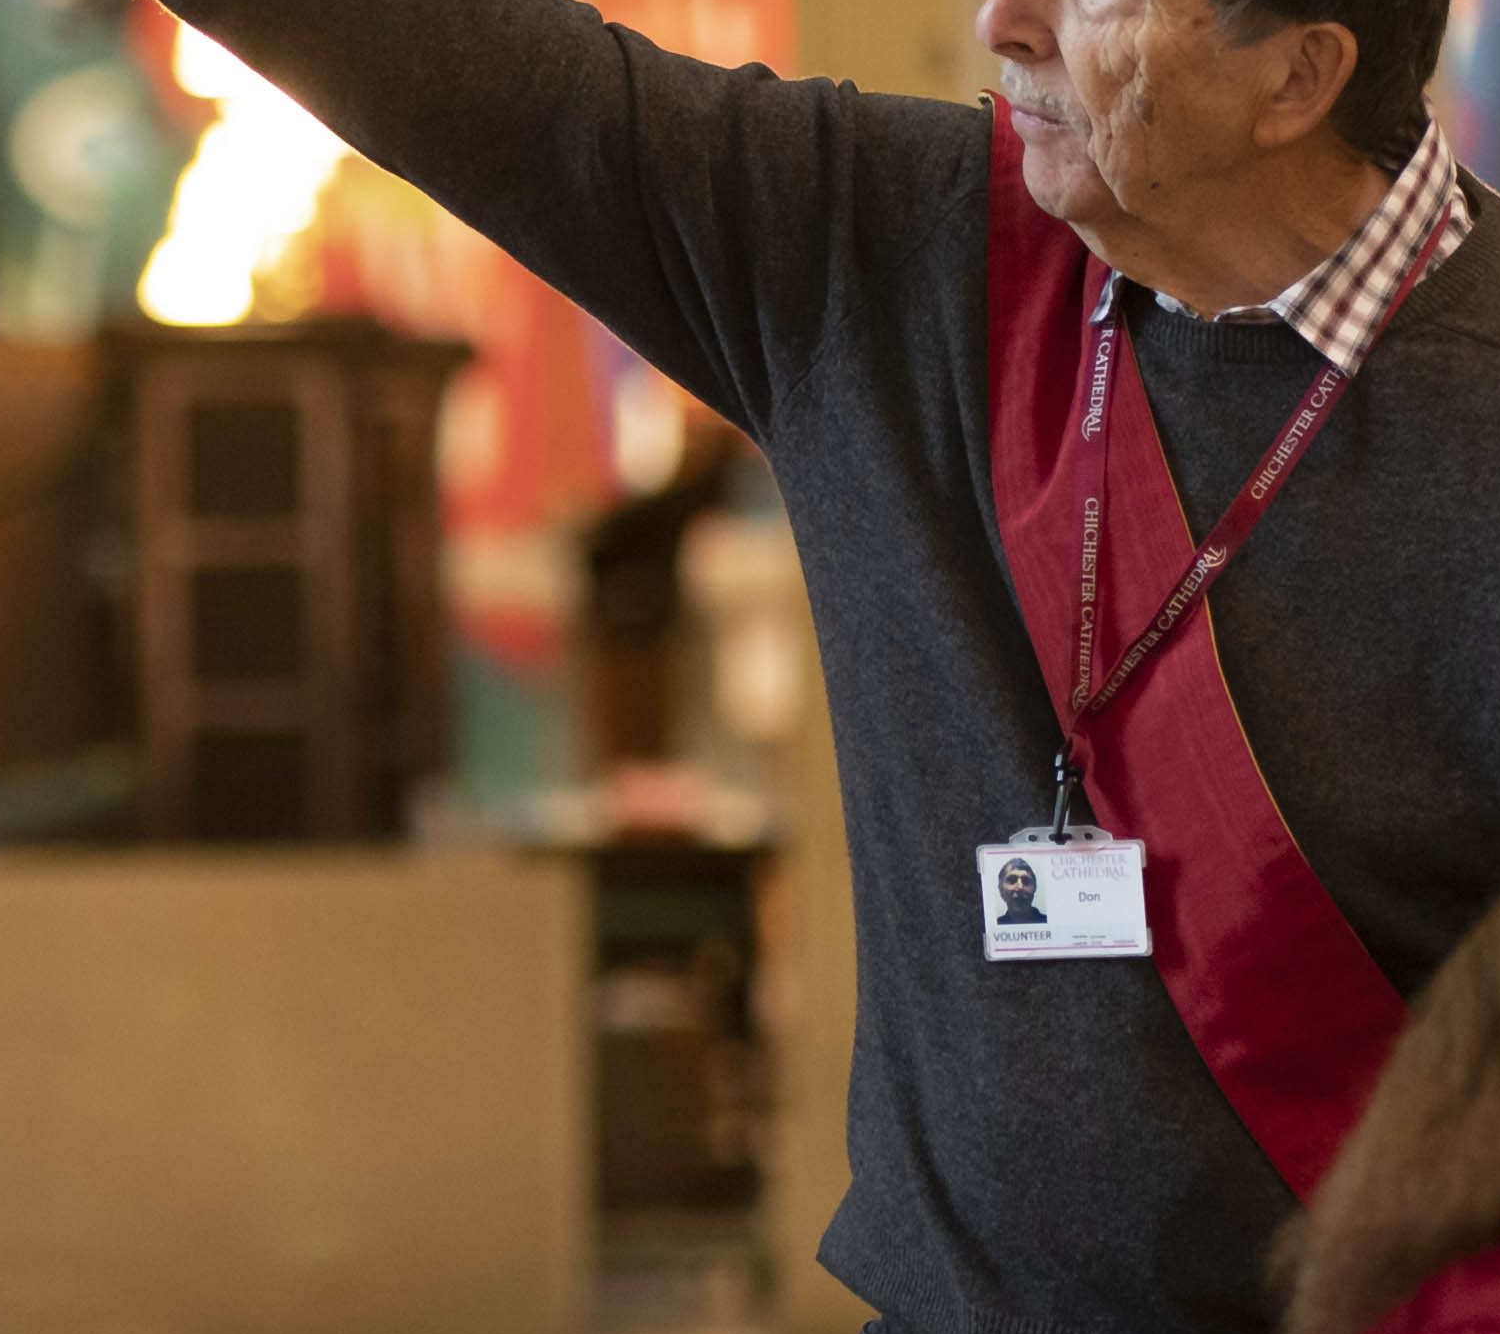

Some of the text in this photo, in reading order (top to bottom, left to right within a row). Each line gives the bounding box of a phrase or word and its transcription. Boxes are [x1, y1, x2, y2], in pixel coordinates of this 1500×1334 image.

[1081, 341, 1111, 442] CATHEDRAL
[1250, 409, 1318, 500] CHICHESTER
[1072, 497, 1099, 711] CHICHESTER CATHEDRAL
[1090, 546, 1227, 711] CHICHESTER CATHEDRAL
[1051, 853, 1127, 867] CHICHESTER
[1052, 867, 1129, 881] CATHEDRAL
[1078, 891, 1101, 903] Don
[993, 930, 1052, 942] VOLUNTEER
